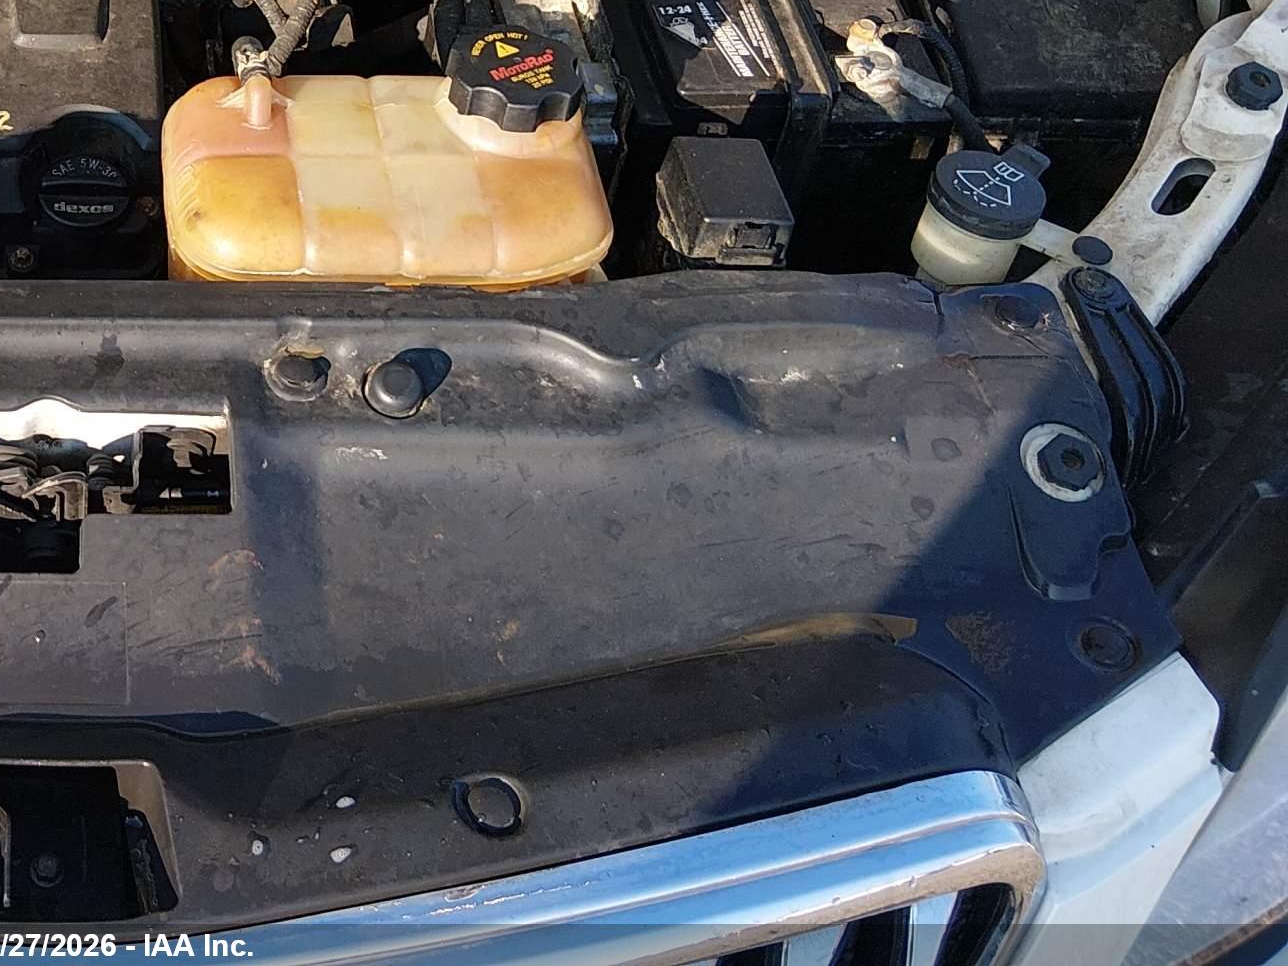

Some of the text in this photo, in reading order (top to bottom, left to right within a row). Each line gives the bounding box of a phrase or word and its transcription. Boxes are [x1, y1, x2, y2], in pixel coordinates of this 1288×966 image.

[658, 4, 693, 15] 12-24
[51, 160, 75, 177] SAE
[53, 201, 114, 214] dexos
